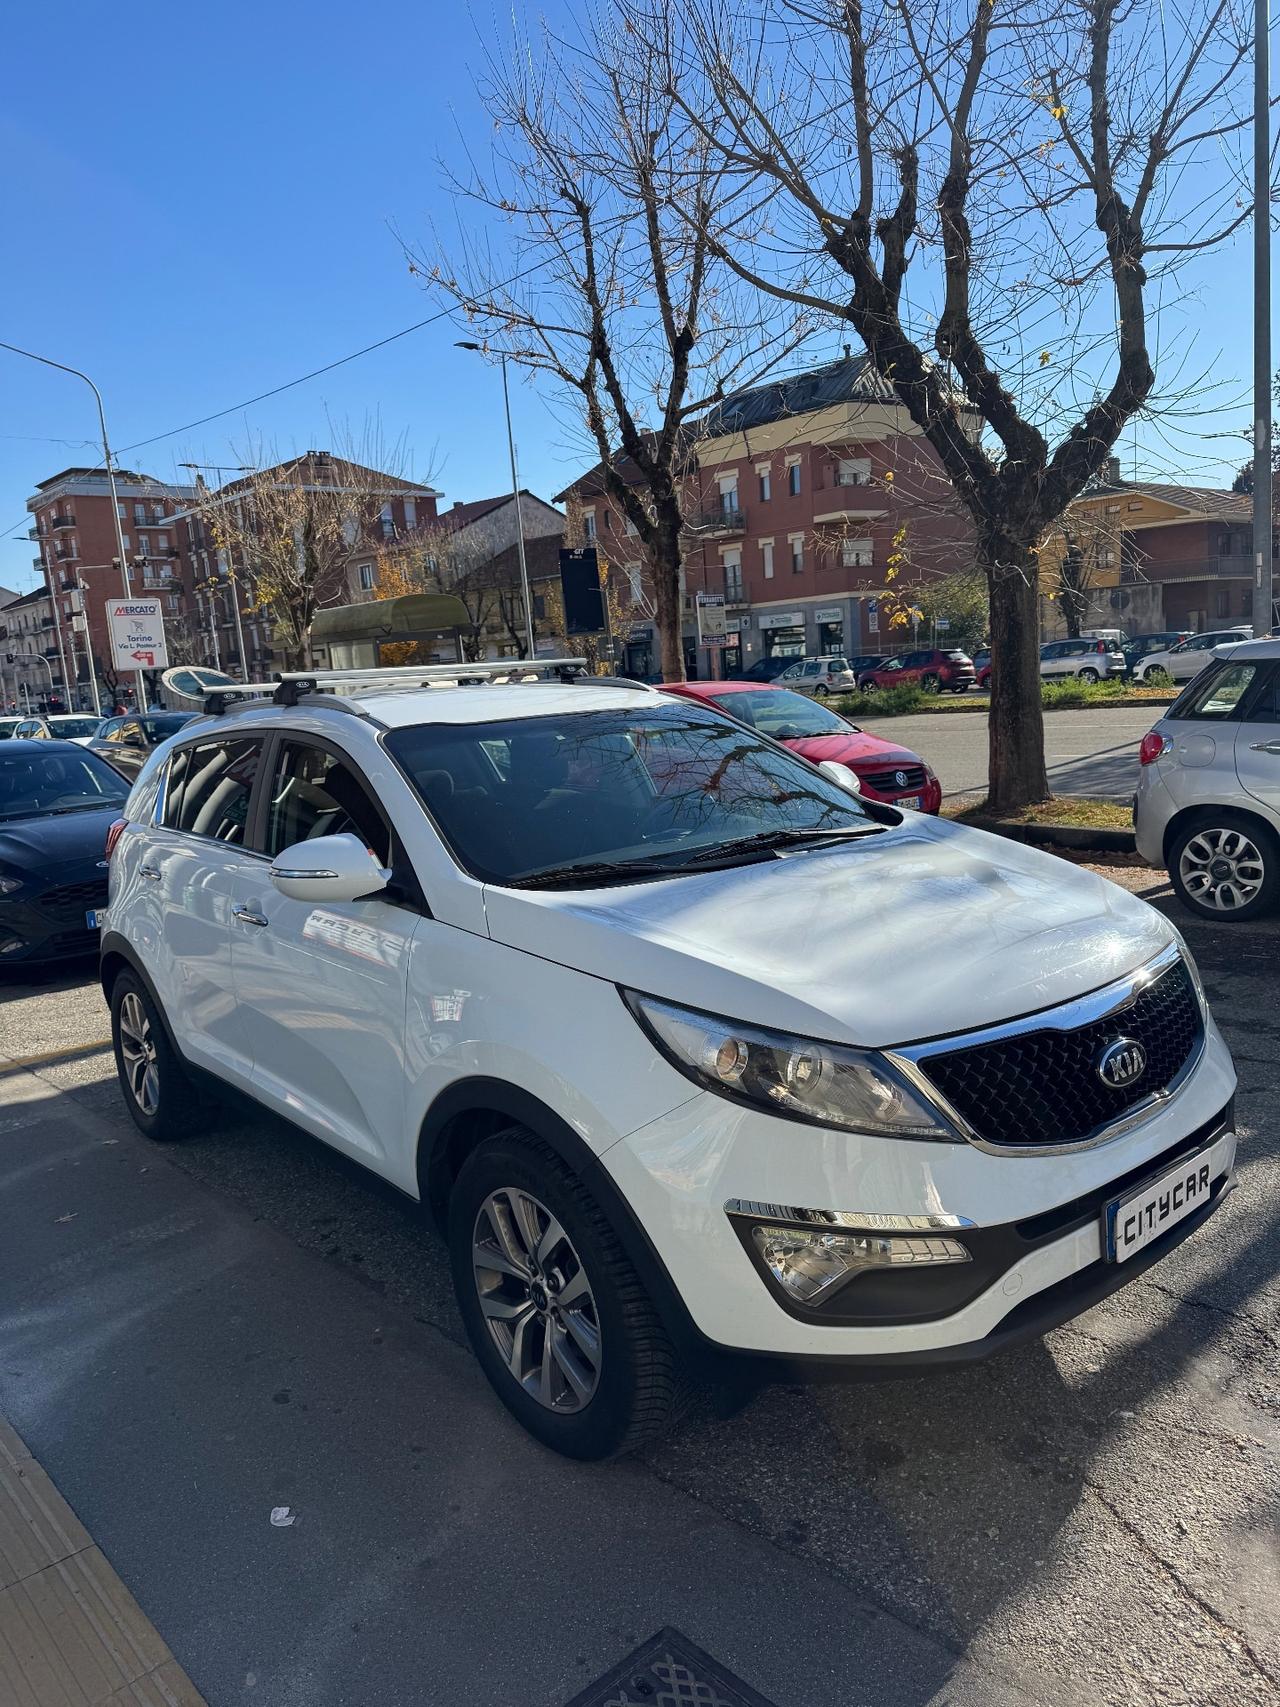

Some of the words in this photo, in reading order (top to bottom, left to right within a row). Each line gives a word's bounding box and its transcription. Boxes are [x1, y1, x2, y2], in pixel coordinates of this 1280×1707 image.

[127, 634, 153, 642] Torino
[1109, 1047, 1144, 1082] KIA
[1123, 1164, 1210, 1246] CITYCAR
